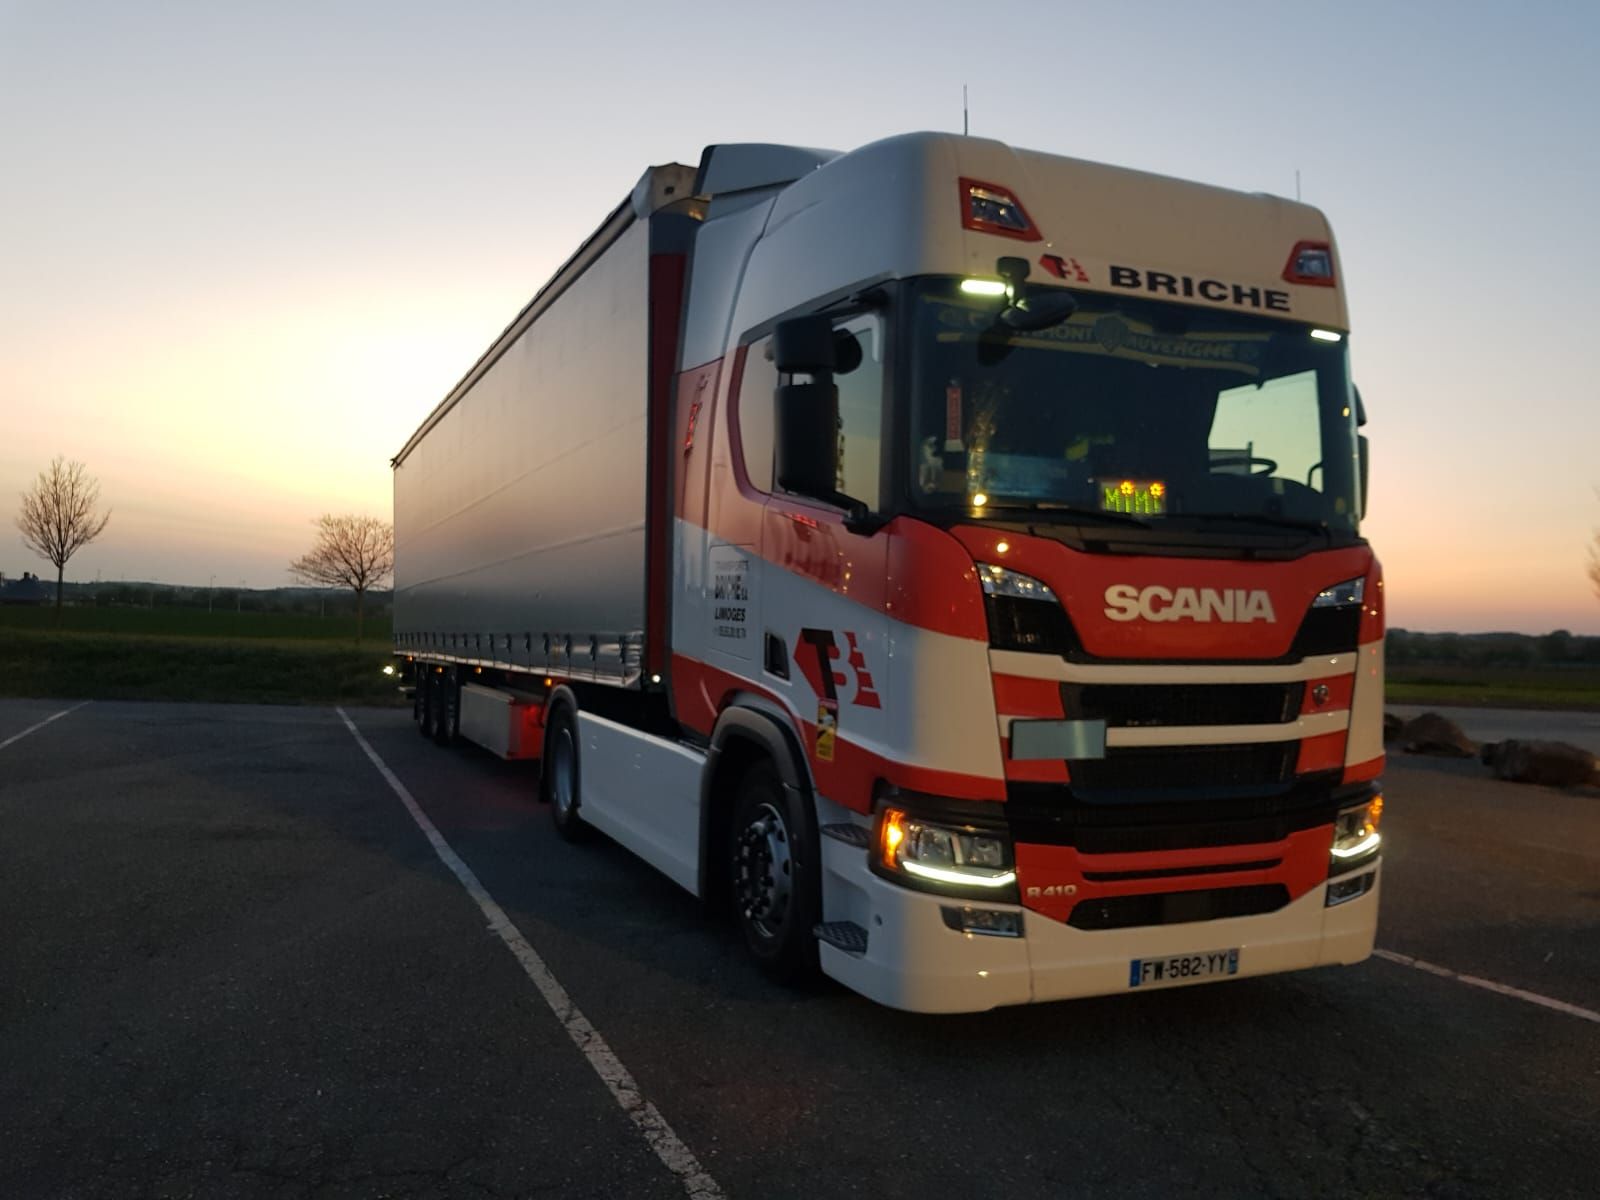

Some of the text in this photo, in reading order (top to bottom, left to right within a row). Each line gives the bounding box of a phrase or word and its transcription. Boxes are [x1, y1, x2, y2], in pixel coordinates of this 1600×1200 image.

[1109, 265, 1291, 312] BRICHE
[1103, 584, 1276, 623] SCANIA
[1026, 884, 1078, 898] R 410
